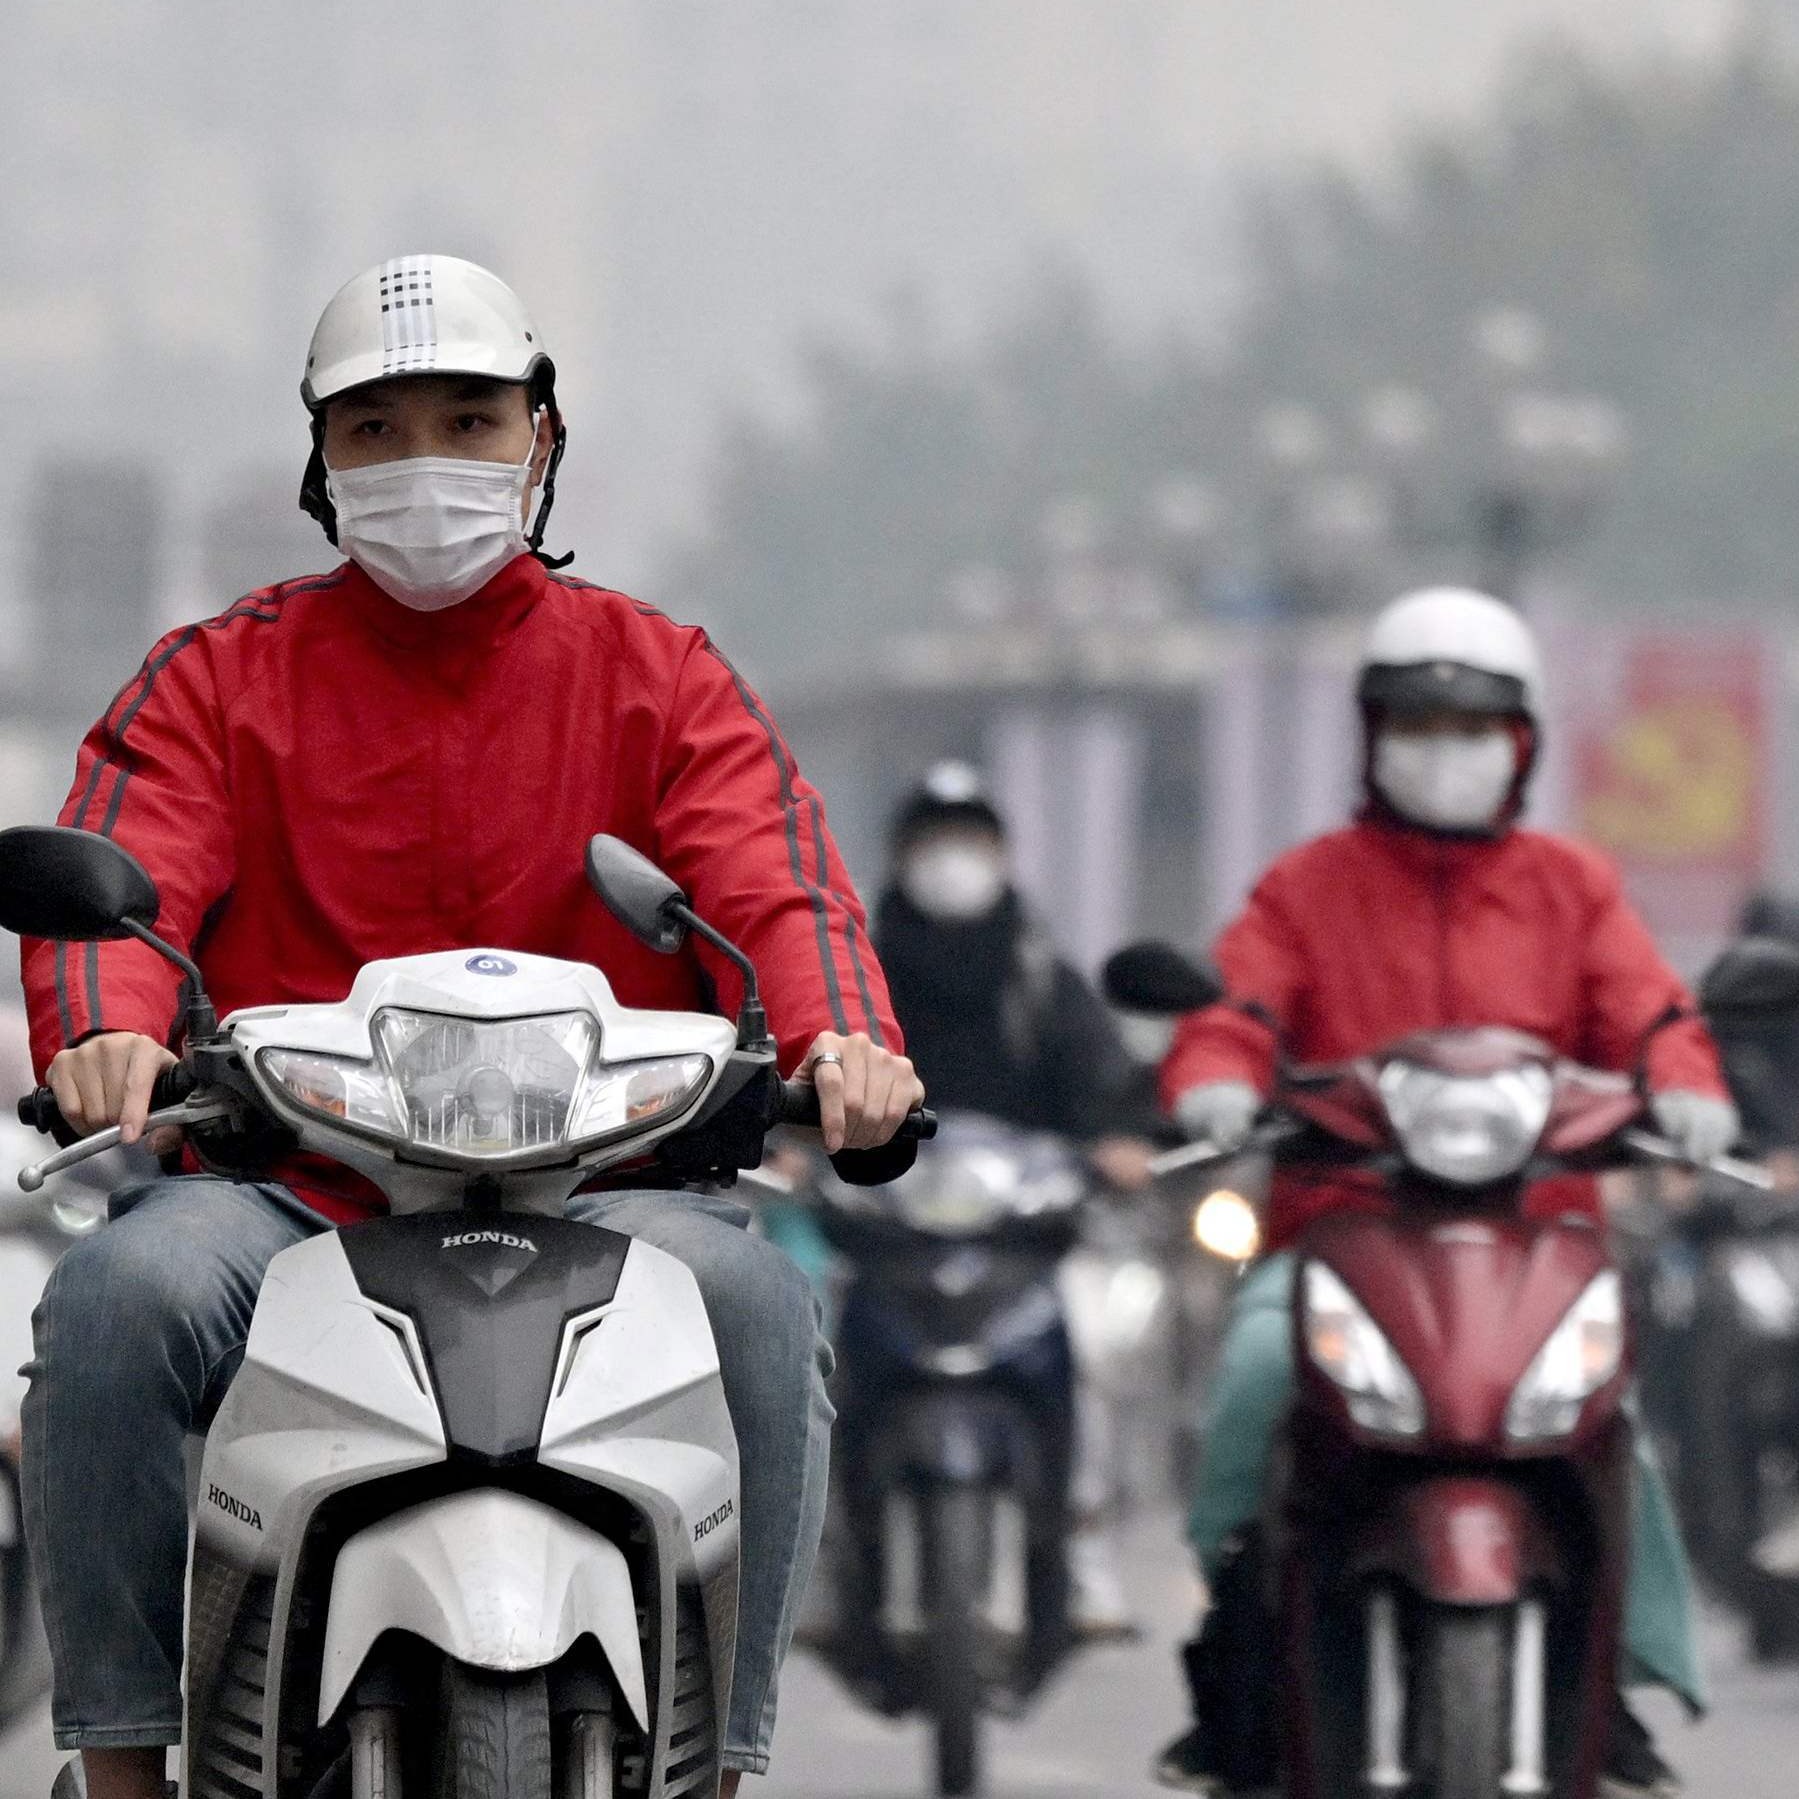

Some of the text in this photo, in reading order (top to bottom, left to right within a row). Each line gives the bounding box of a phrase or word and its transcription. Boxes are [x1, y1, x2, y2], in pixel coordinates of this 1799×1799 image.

[441, 1231, 538, 1253] HONDA
[208, 1483, 263, 1531] HONDA
[694, 1499, 734, 1542] HONDA
